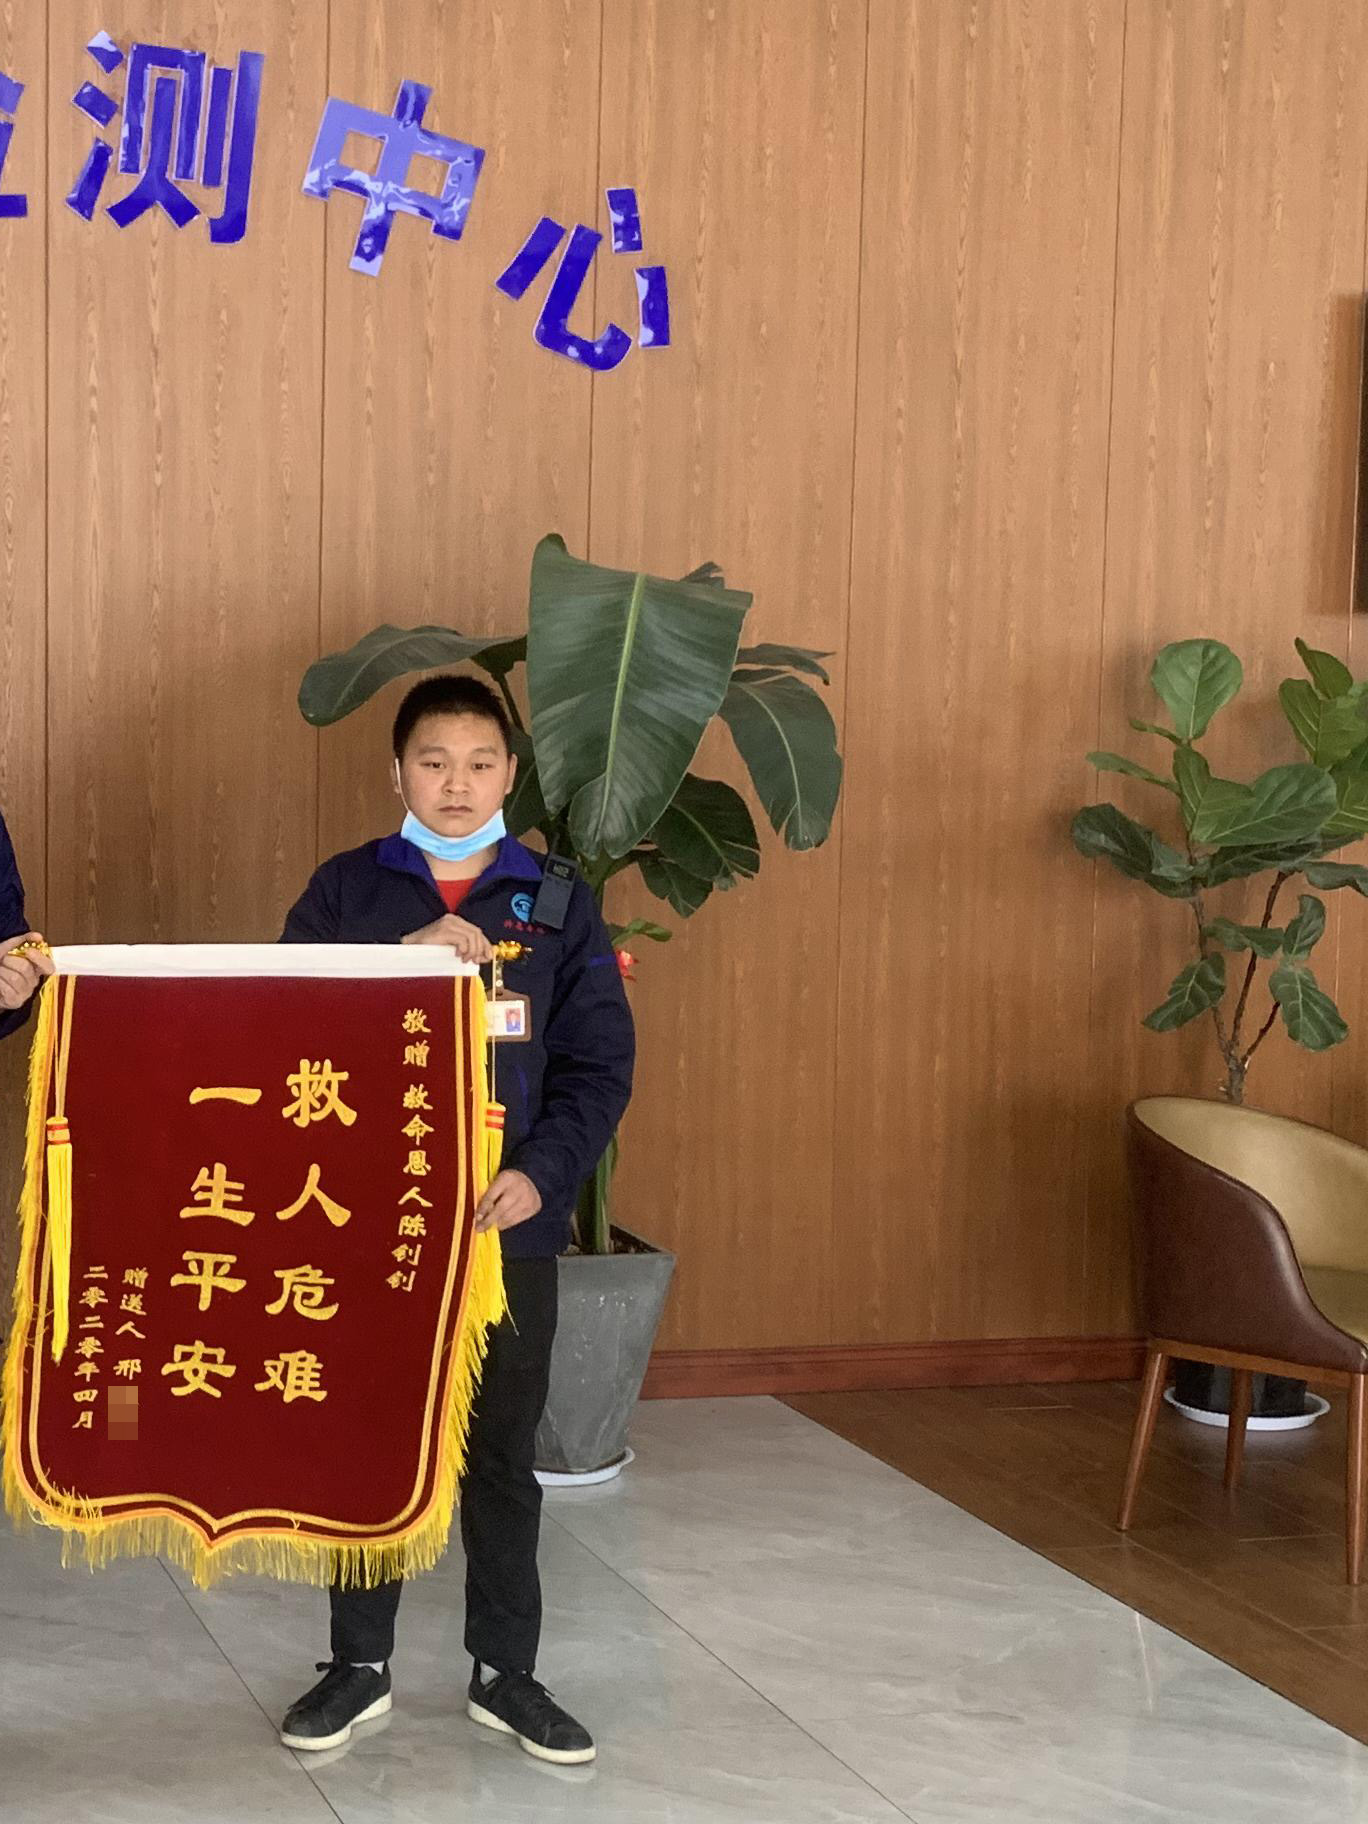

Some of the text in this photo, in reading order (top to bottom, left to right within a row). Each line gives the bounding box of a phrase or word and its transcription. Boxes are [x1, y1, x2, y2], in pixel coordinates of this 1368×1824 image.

[72, 1265, 109, 1429] 二零二零年四月
[161, 1086, 262, 1399] 一生平安
[254, 1058, 357, 1404] 救人危难
